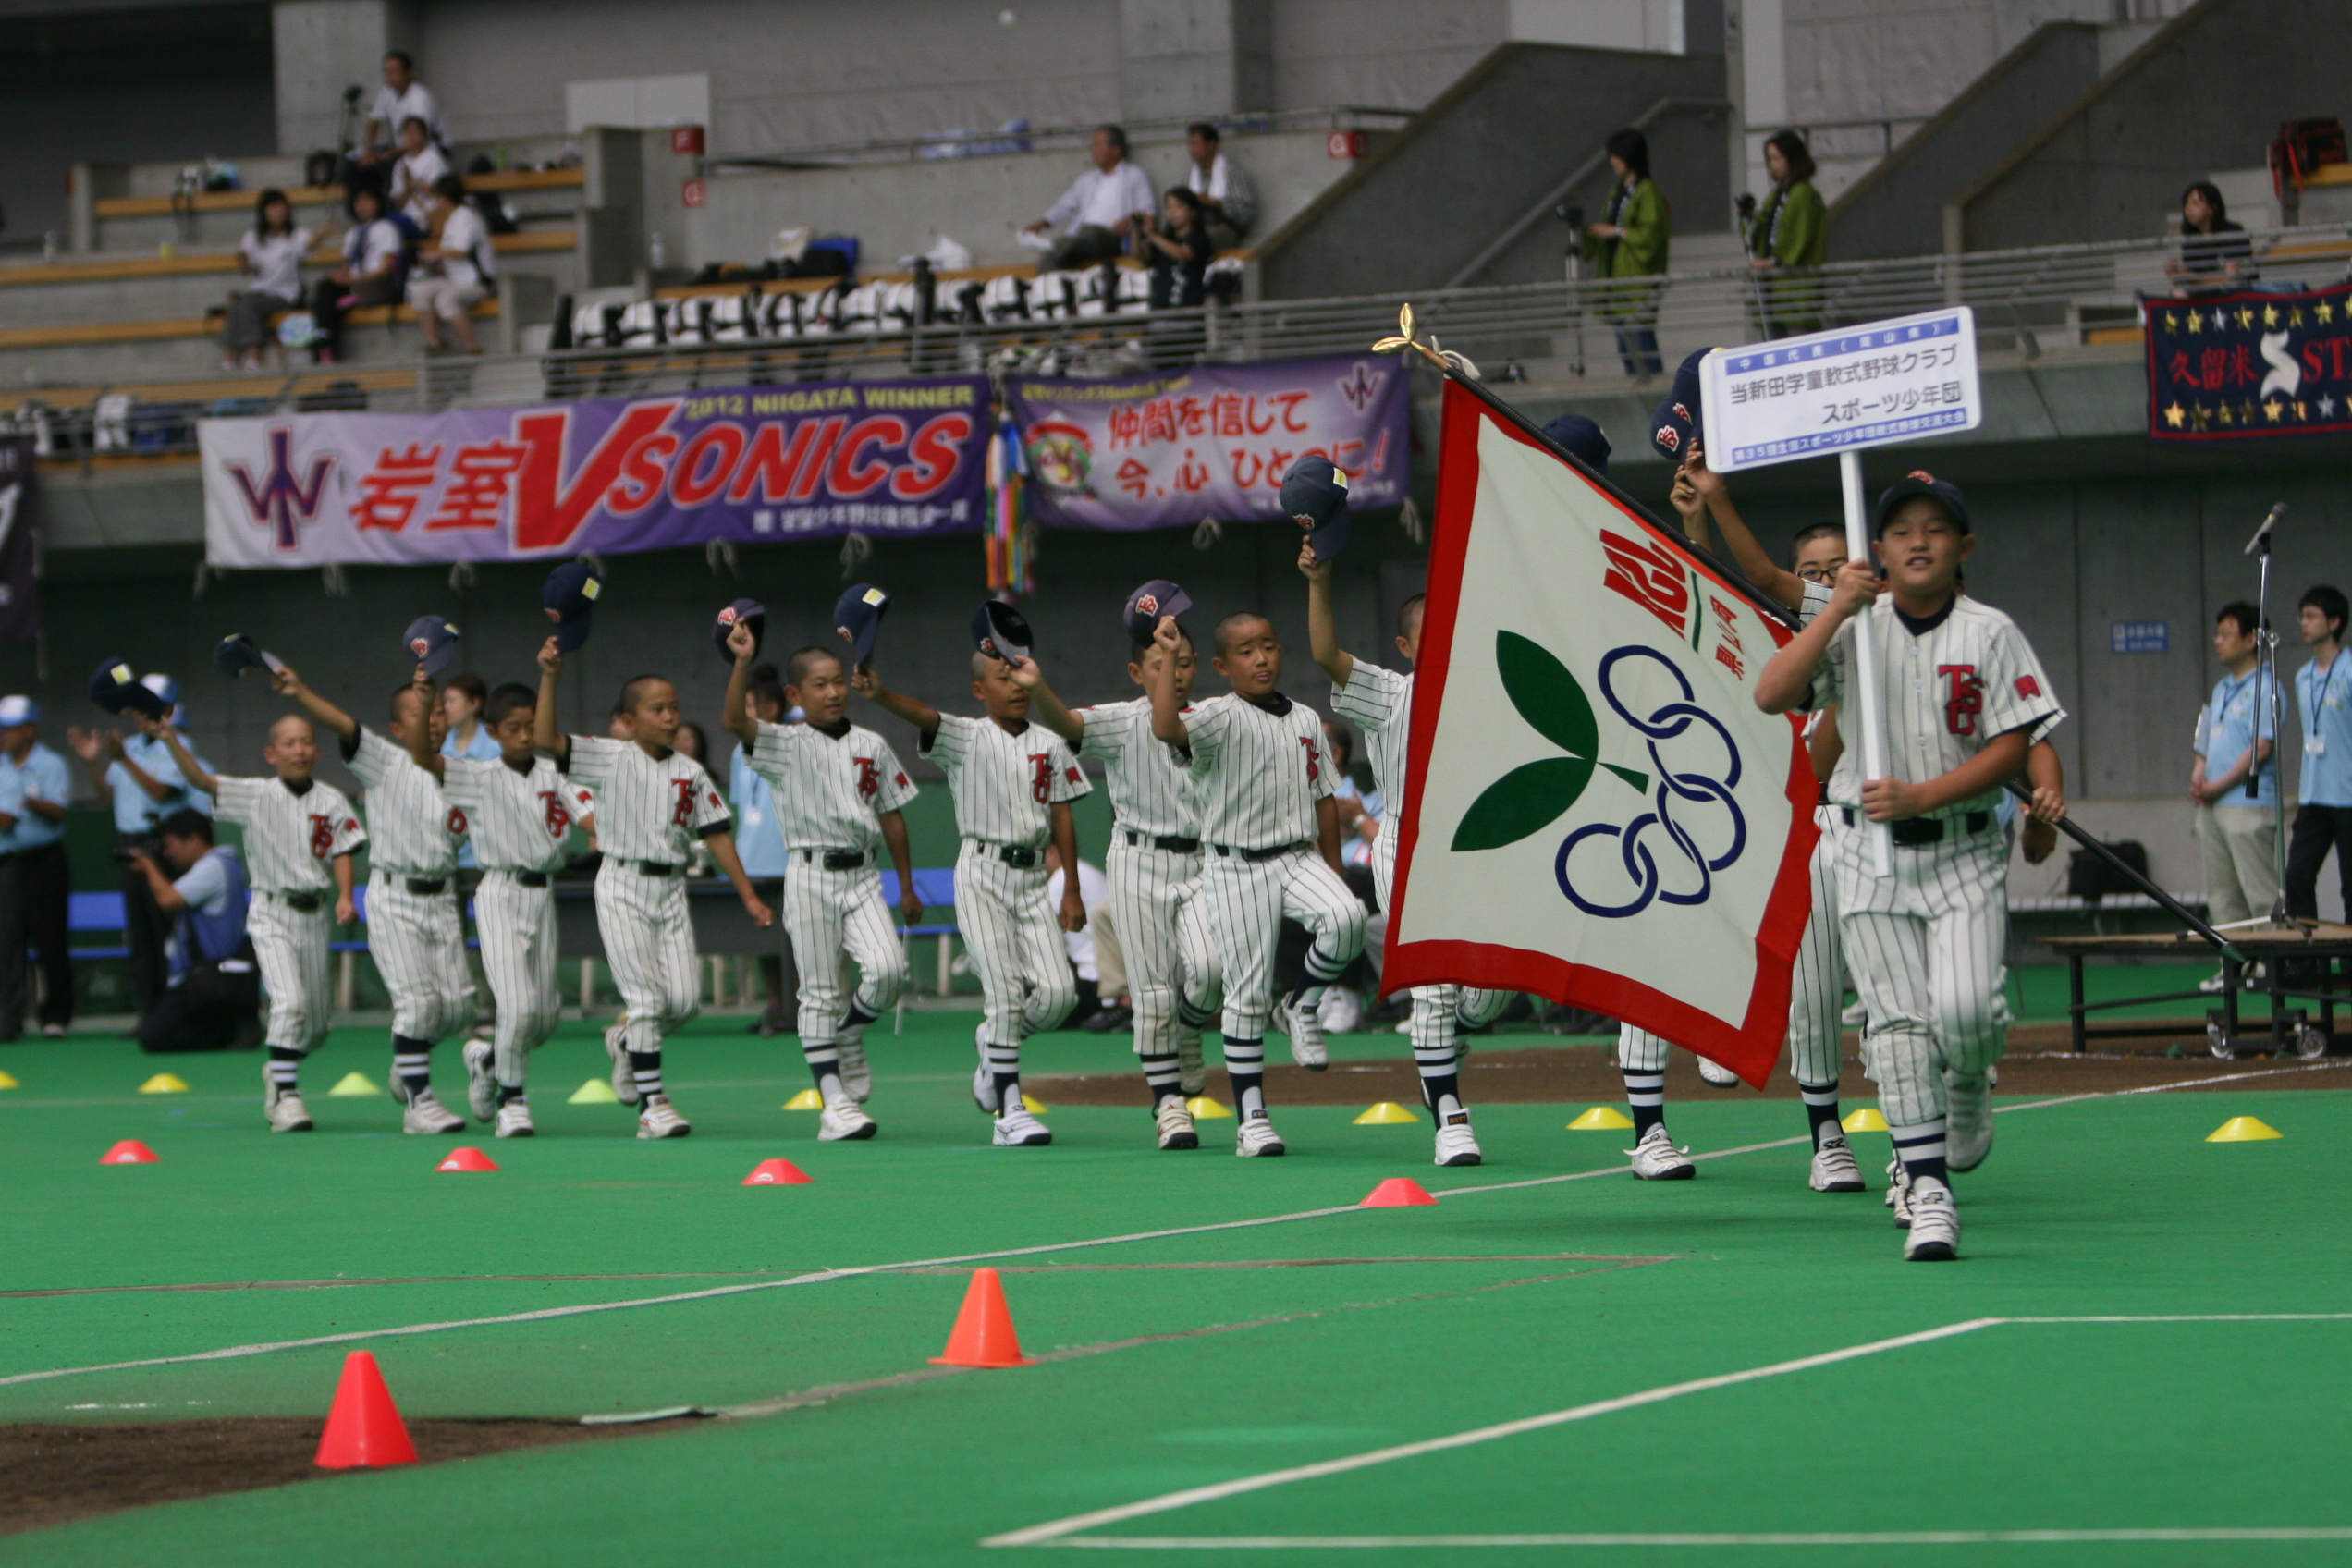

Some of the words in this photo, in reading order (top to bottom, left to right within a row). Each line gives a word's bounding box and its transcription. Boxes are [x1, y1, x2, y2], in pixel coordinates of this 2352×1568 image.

[1730, 344, 1958, 404] 当新田学童軟式野球クラブ
[2168, 344, 2260, 392] 久留米
[2302, 336, 2352, 384] ST
[686, 392, 746, 421] 2012
[752, 387, 857, 415] NIIGATA
[864, 385, 974, 409] WINNER
[1107, 389, 1311, 451] 仲間を信じて
[1821, 380, 1962, 424] スポーツ少年団
